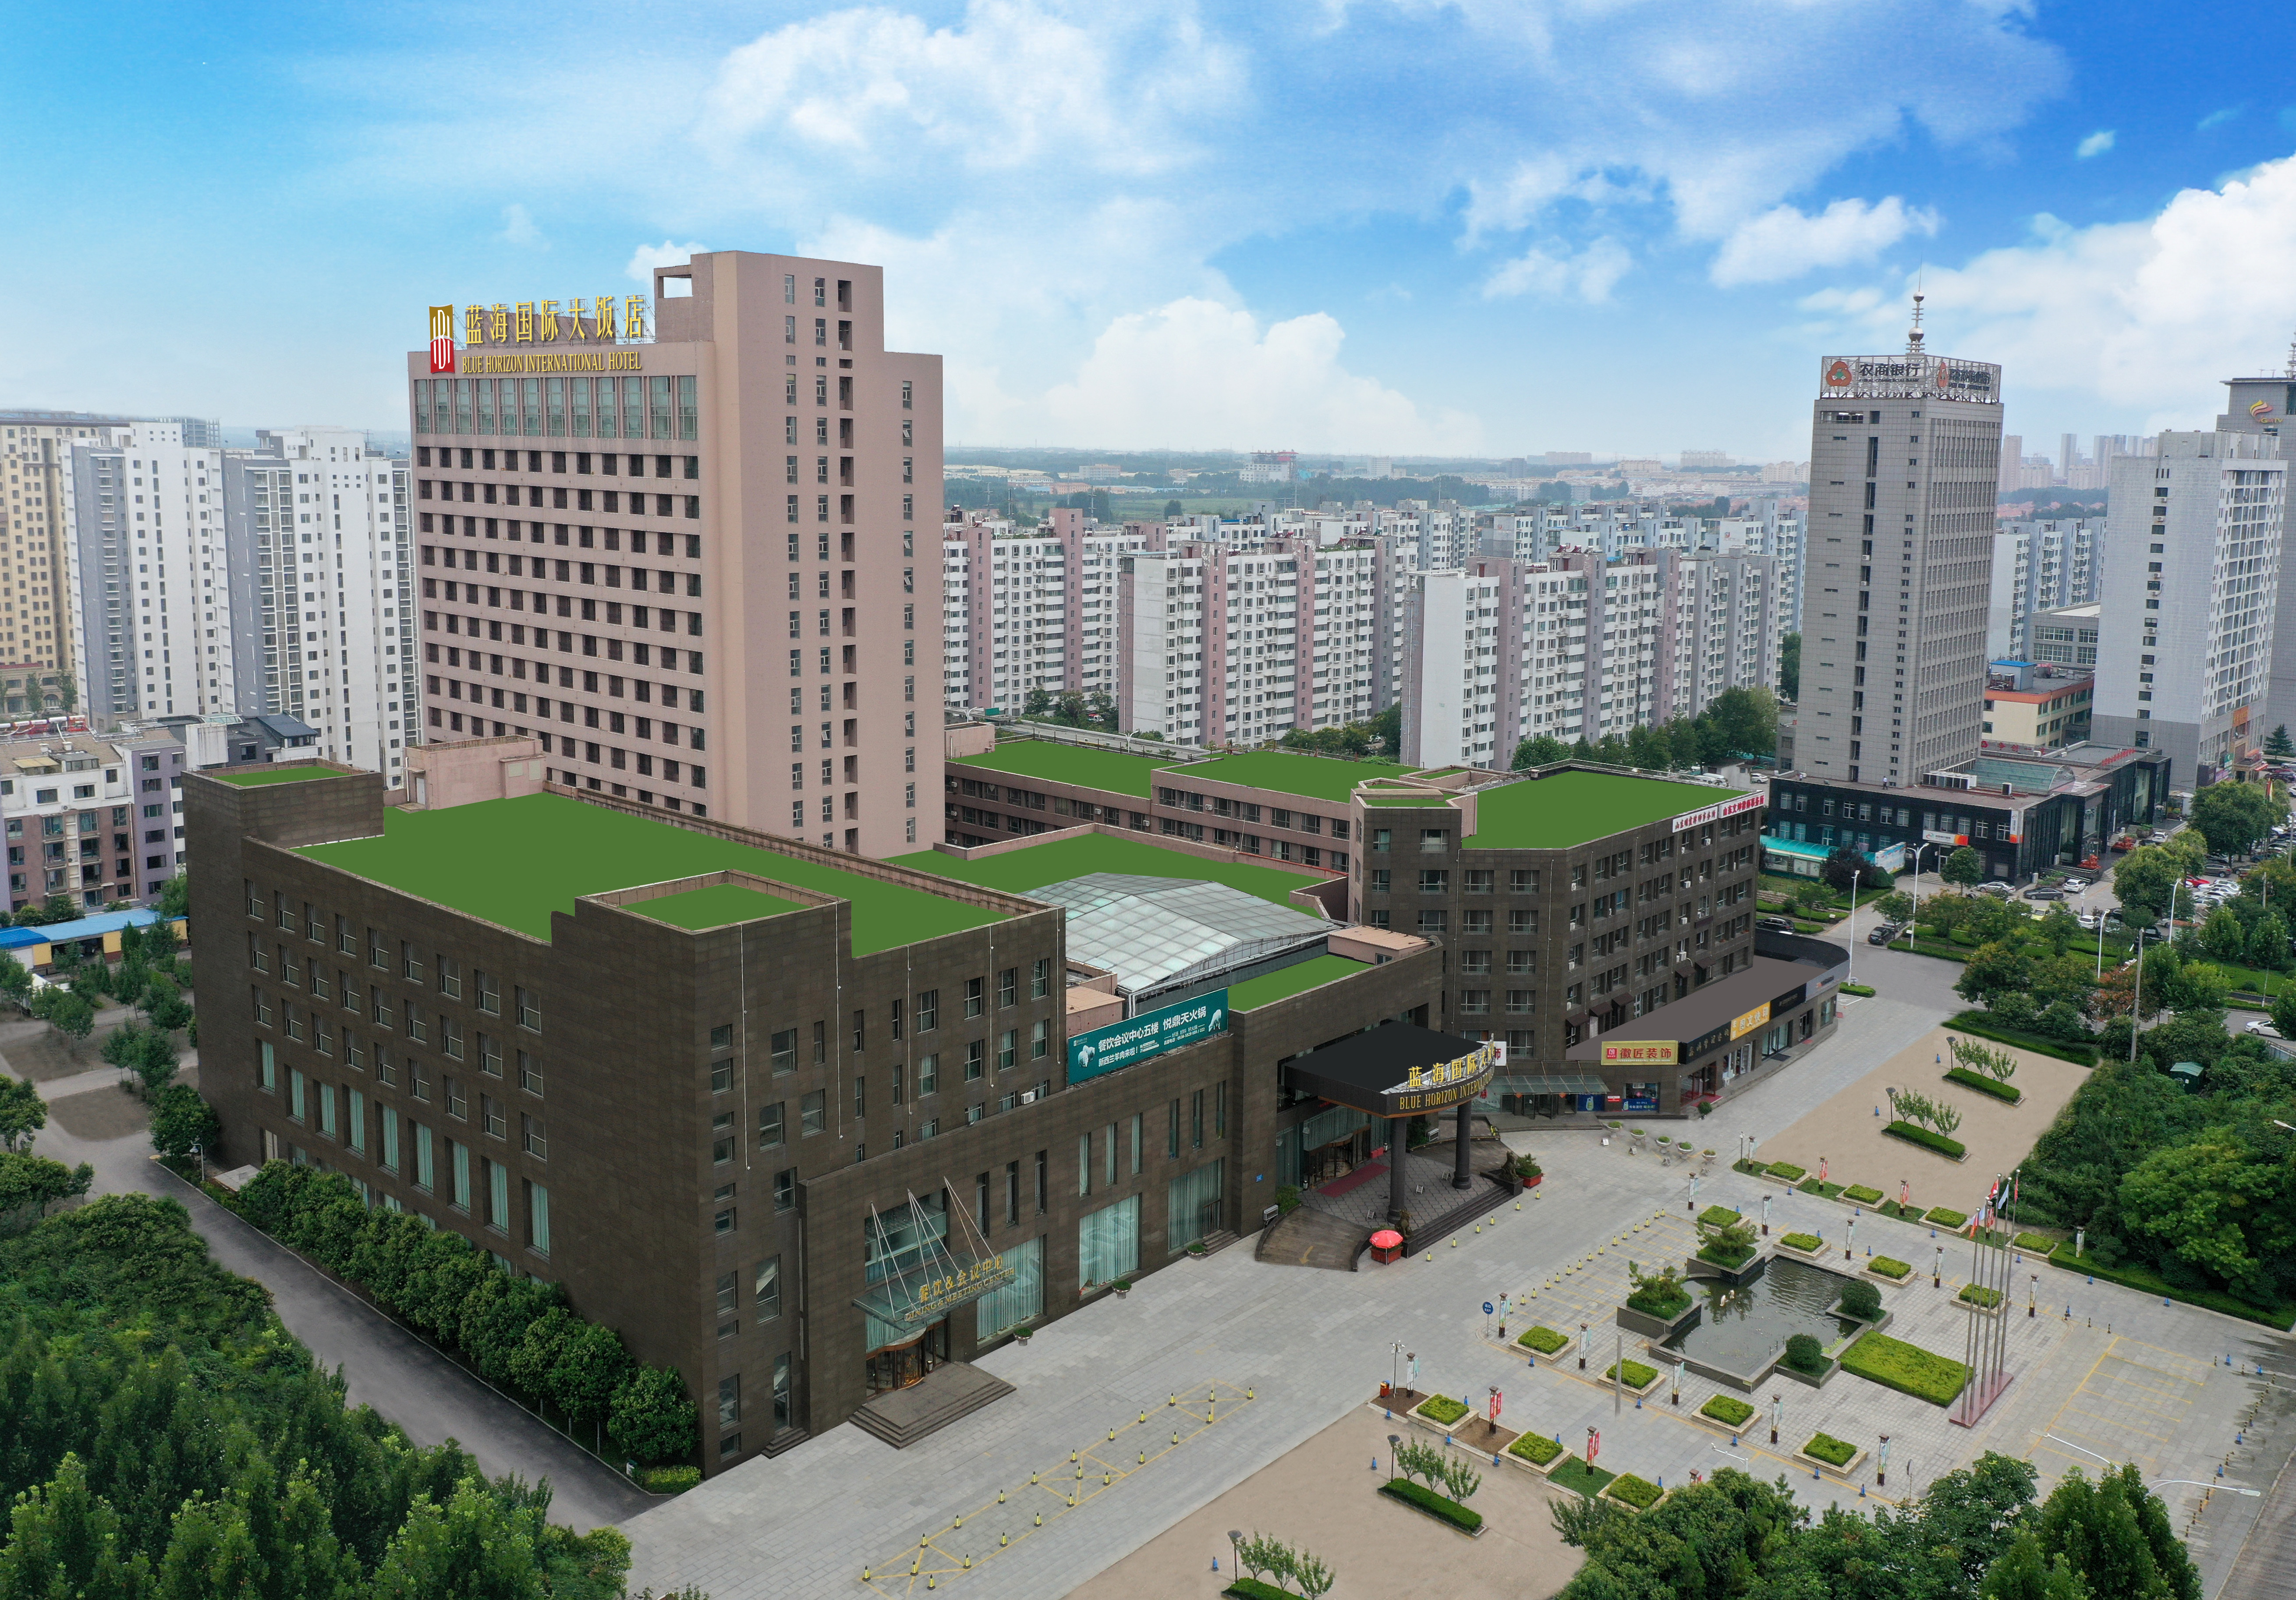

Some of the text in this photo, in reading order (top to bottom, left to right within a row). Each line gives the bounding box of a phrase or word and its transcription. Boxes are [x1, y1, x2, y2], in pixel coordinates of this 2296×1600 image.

[465, 295, 644, 344] 蓝海国际大饭店
[462, 352, 641, 373] BLUE HORIZON INTERNATIONAL HOTEL
[1858, 363, 1920, 376] 农商银行
[1098, 1021, 1159, 1052] 餐饮会议中心五楼
[1162, 1006, 1206, 1031] 悦鼎天火锅
[1620, 1048, 1672, 1059] 徽匠装饰
[1400, 1095, 1422, 1110] BLUE
[1425, 1087, 1457, 1107] HORIZON
[906, 1302, 936, 1320] DINING
[946, 1283, 982, 1303] MEETING
[983, 1267, 1014, 1287] CENTER
